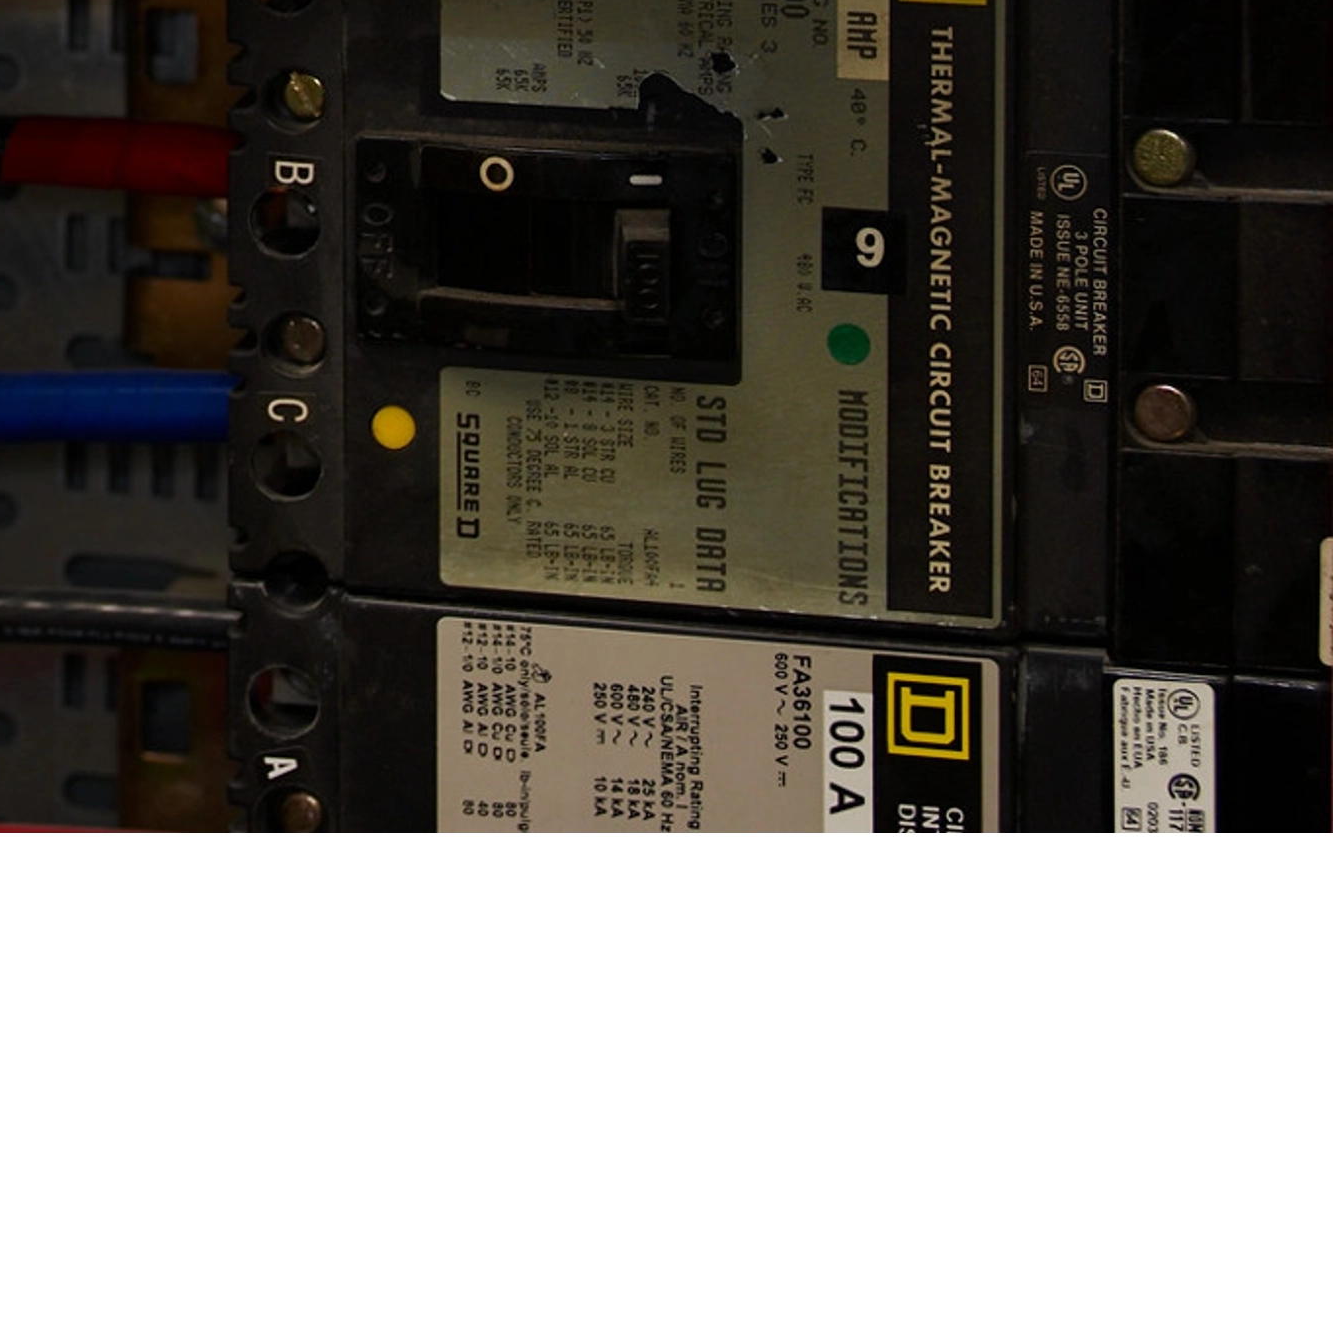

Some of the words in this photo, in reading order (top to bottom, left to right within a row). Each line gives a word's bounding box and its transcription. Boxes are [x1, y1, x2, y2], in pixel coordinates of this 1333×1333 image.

[760, 39, 778, 54] 3
[812, 18, 829, 48] NO.
[846, 11, 878, 60] AMP
[274, 160, 315, 185] B
[928, 26, 954, 332] THERMAL-MAGNETIC
[1029, 211, 1044, 259] MADE
[1055, 214, 1071, 262] ISSUE
[1074, 231, 1089, 241] 3
[1092, 208, 1108, 275] CIRCUIT
[1029, 262, 1044, 280] IN
[1074, 244, 1089, 288] POLE
[1028, 284, 1044, 331] U.S.A.
[1055, 266, 1071, 331] NE-6558
[1074, 292, 1089, 331] UNIT
[1092, 279, 1108, 356] BREAKER
[267, 398, 309, 422] C
[696, 395, 727, 444] STD
[929, 342, 952, 453] CIRCUIT
[456, 412, 481, 513] SQUARE
[695, 460, 727, 510] LUG
[837, 389, 869, 606] MODIFICATIONS
[456, 516, 480, 540] D
[928, 464, 951, 592] BREAKER
[695, 526, 727, 593] DATA
[792, 654, 812, 750] FA36100
[659, 675, 675, 787] UL/CSA/NEMA
[682, 684, 704, 776] Interrupting
[829, 697, 866, 770] 100
[264, 756, 298, 780] A
[686, 780, 704, 831] Rating
[829, 782, 866, 815] A
